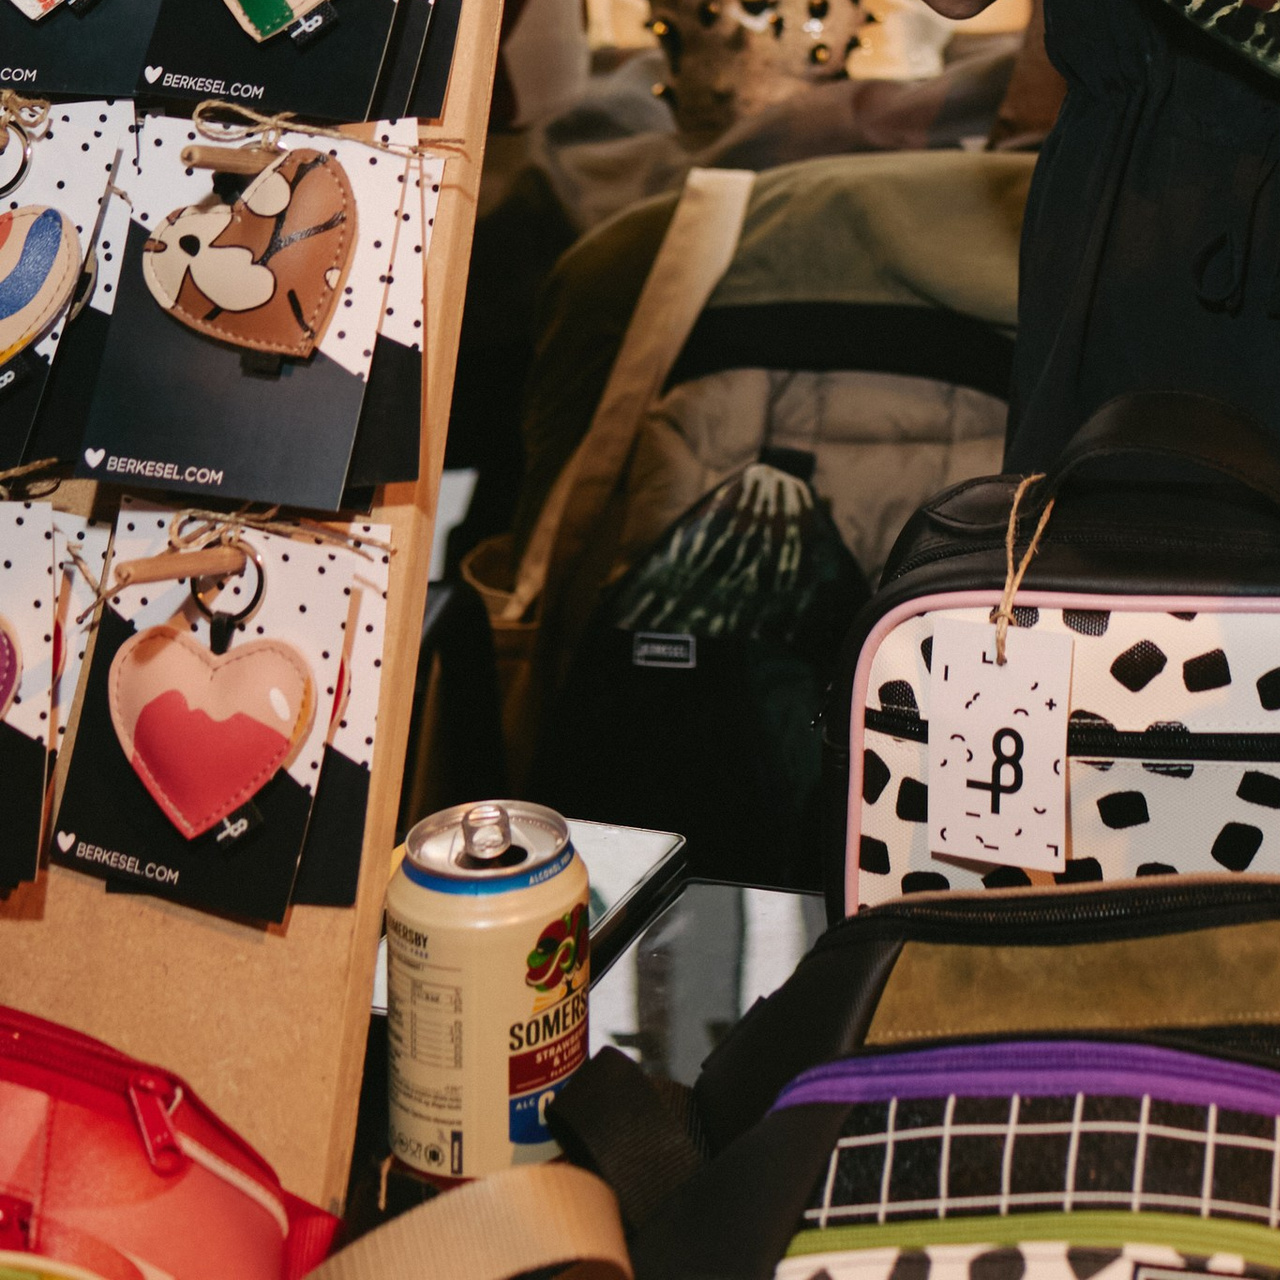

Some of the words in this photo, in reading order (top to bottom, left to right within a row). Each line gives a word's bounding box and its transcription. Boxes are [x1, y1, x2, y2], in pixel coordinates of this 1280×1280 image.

[162, 73, 265, 100] BERKESEL.COM
[106, 456, 224, 486] BERKESEL.COM
[76, 842, 180, 885] BERKESEL.COM
